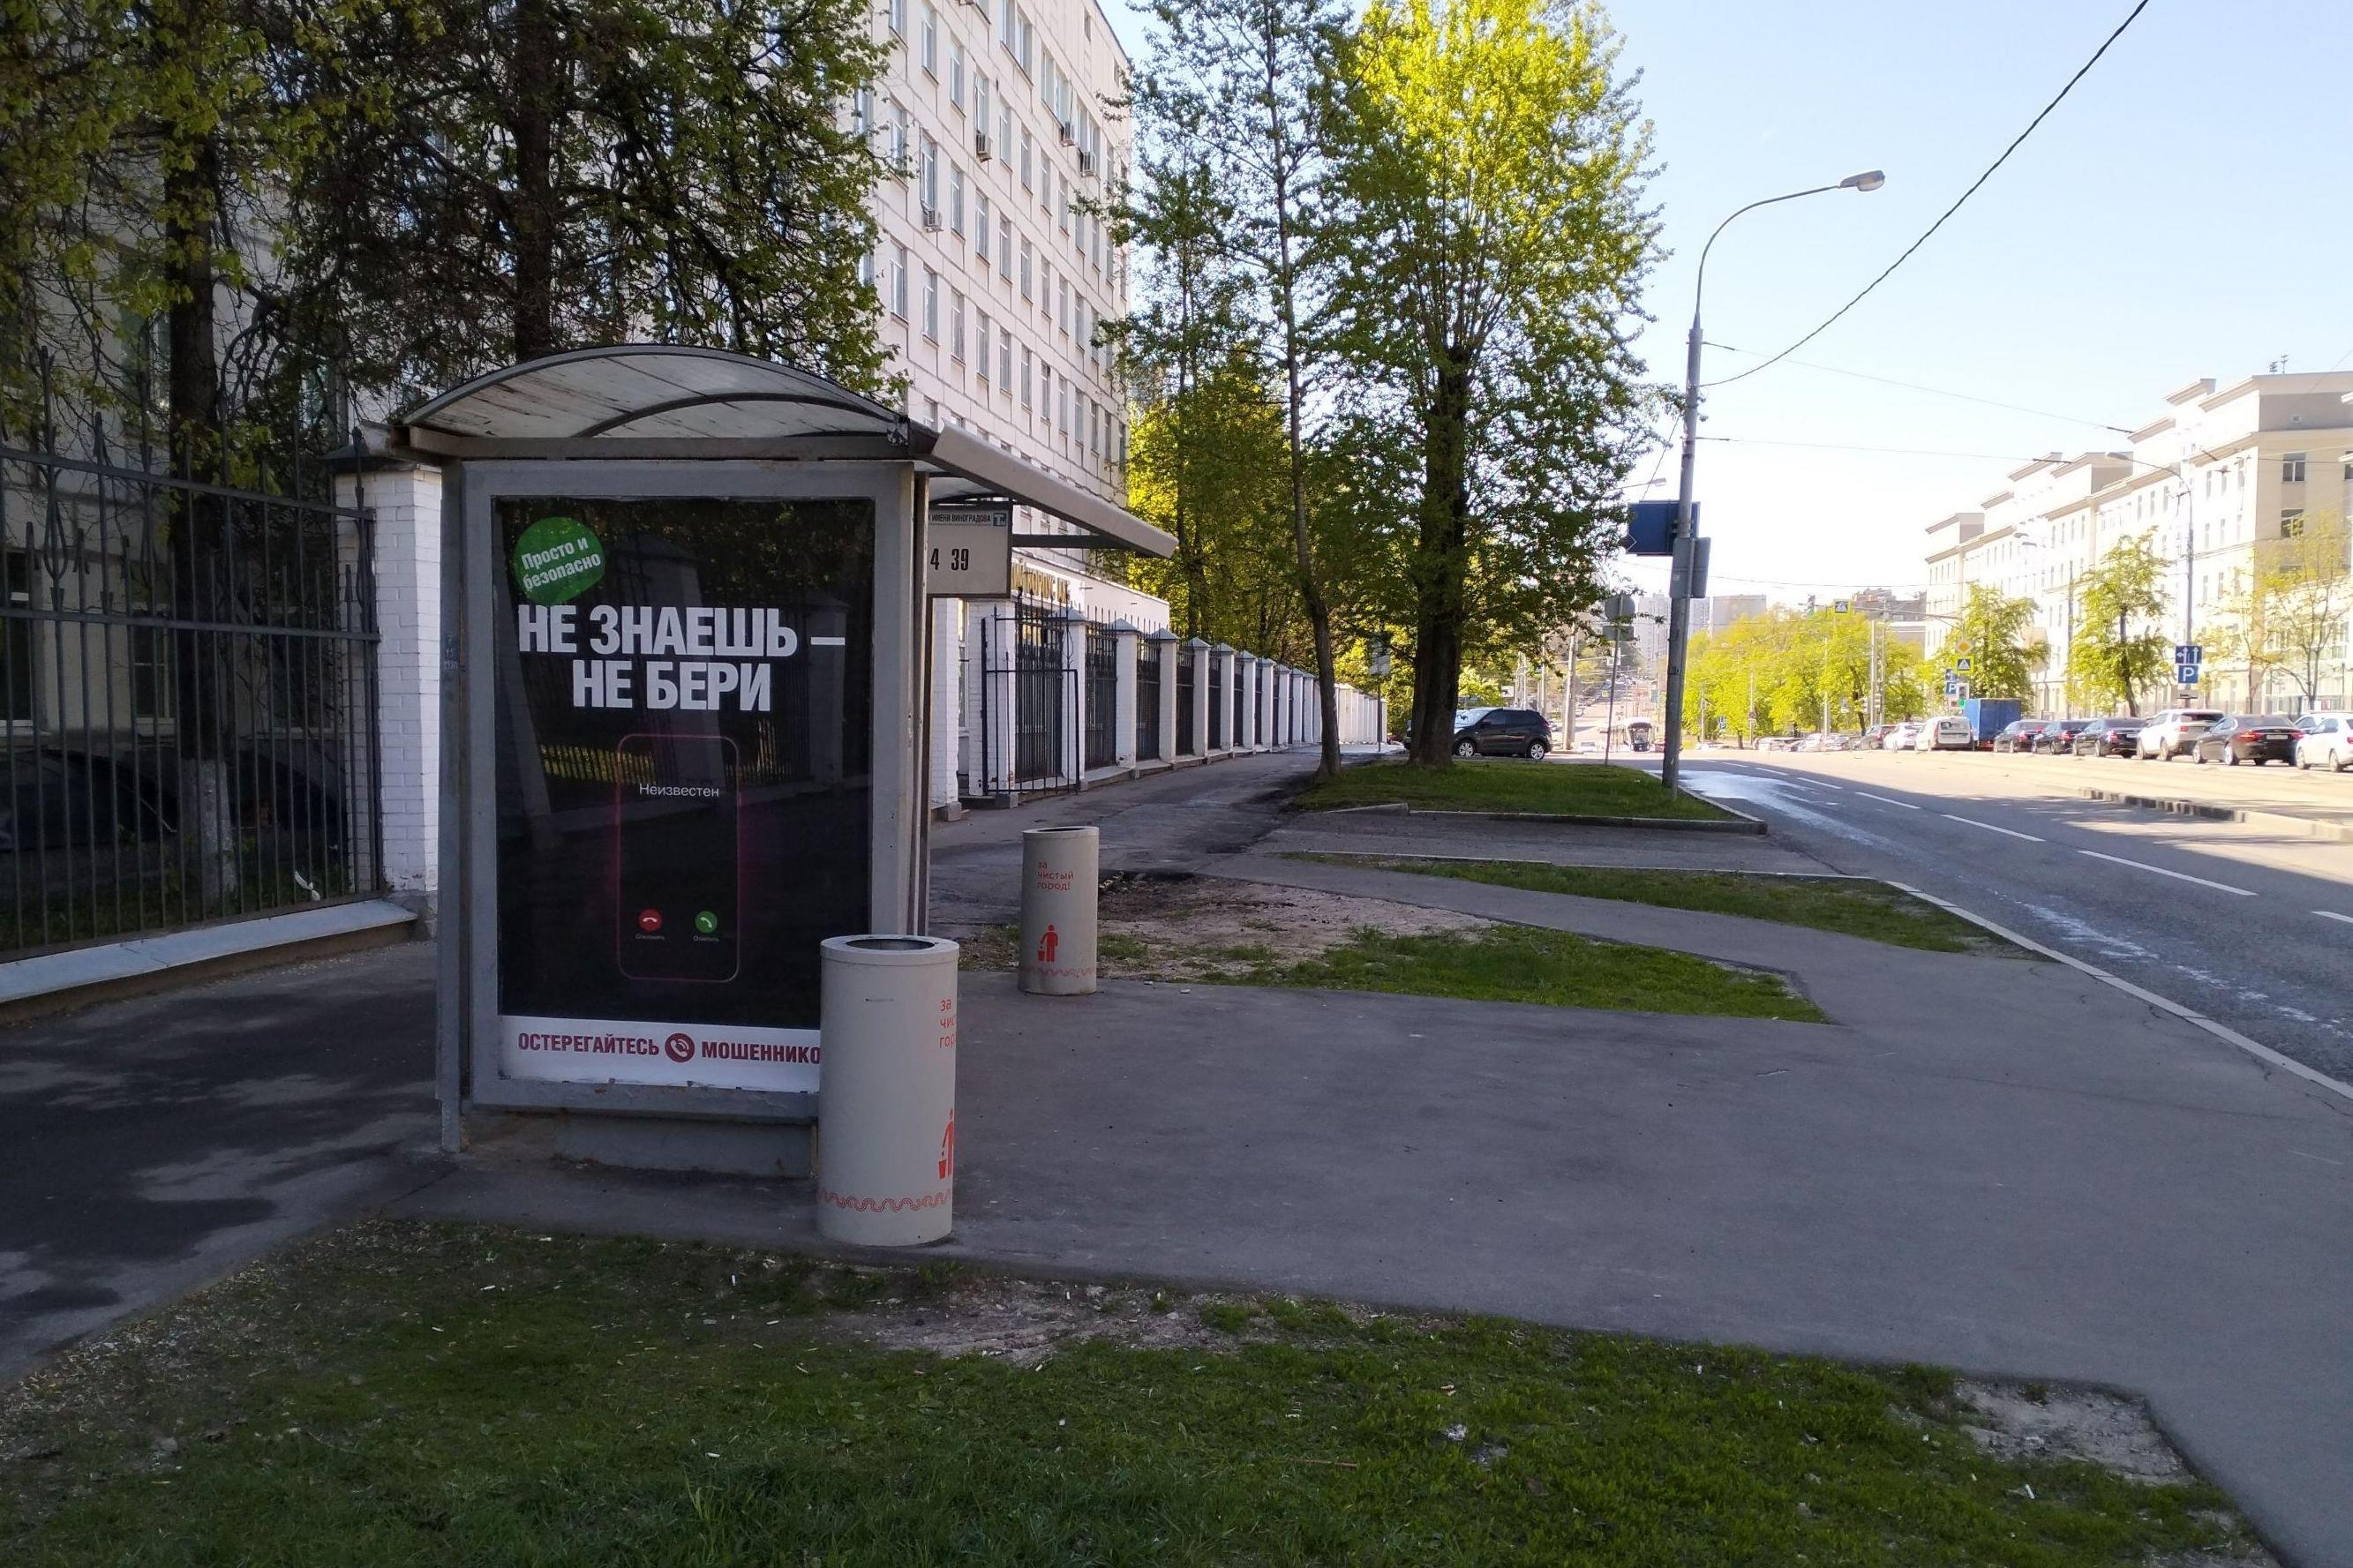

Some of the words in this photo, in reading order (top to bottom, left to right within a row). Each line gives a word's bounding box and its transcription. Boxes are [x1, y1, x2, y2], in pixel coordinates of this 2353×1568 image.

[522, 542, 575, 570] Просто
[577, 537, 589, 551] и
[951, 548, 969, 571] 39
[522, 553, 601, 592] безопасно
[518, 604, 577, 653] НЕ
[590, 605, 798, 657] ЗНАЕШЬ
[573, 659, 633, 709] НЕ
[647, 661, 771, 712] БЕРИ
[639, 783, 719, 797] Неизвестен
[940, 999, 951, 1011] за
[940, 1017, 956, 1028] чис
[518, 1032, 660, 1056] ОСТЕРЕГАЙТЕСЬ
[701, 1040, 821, 1064] МОШЕННИКО
[940, 1033, 956, 1049] гор
